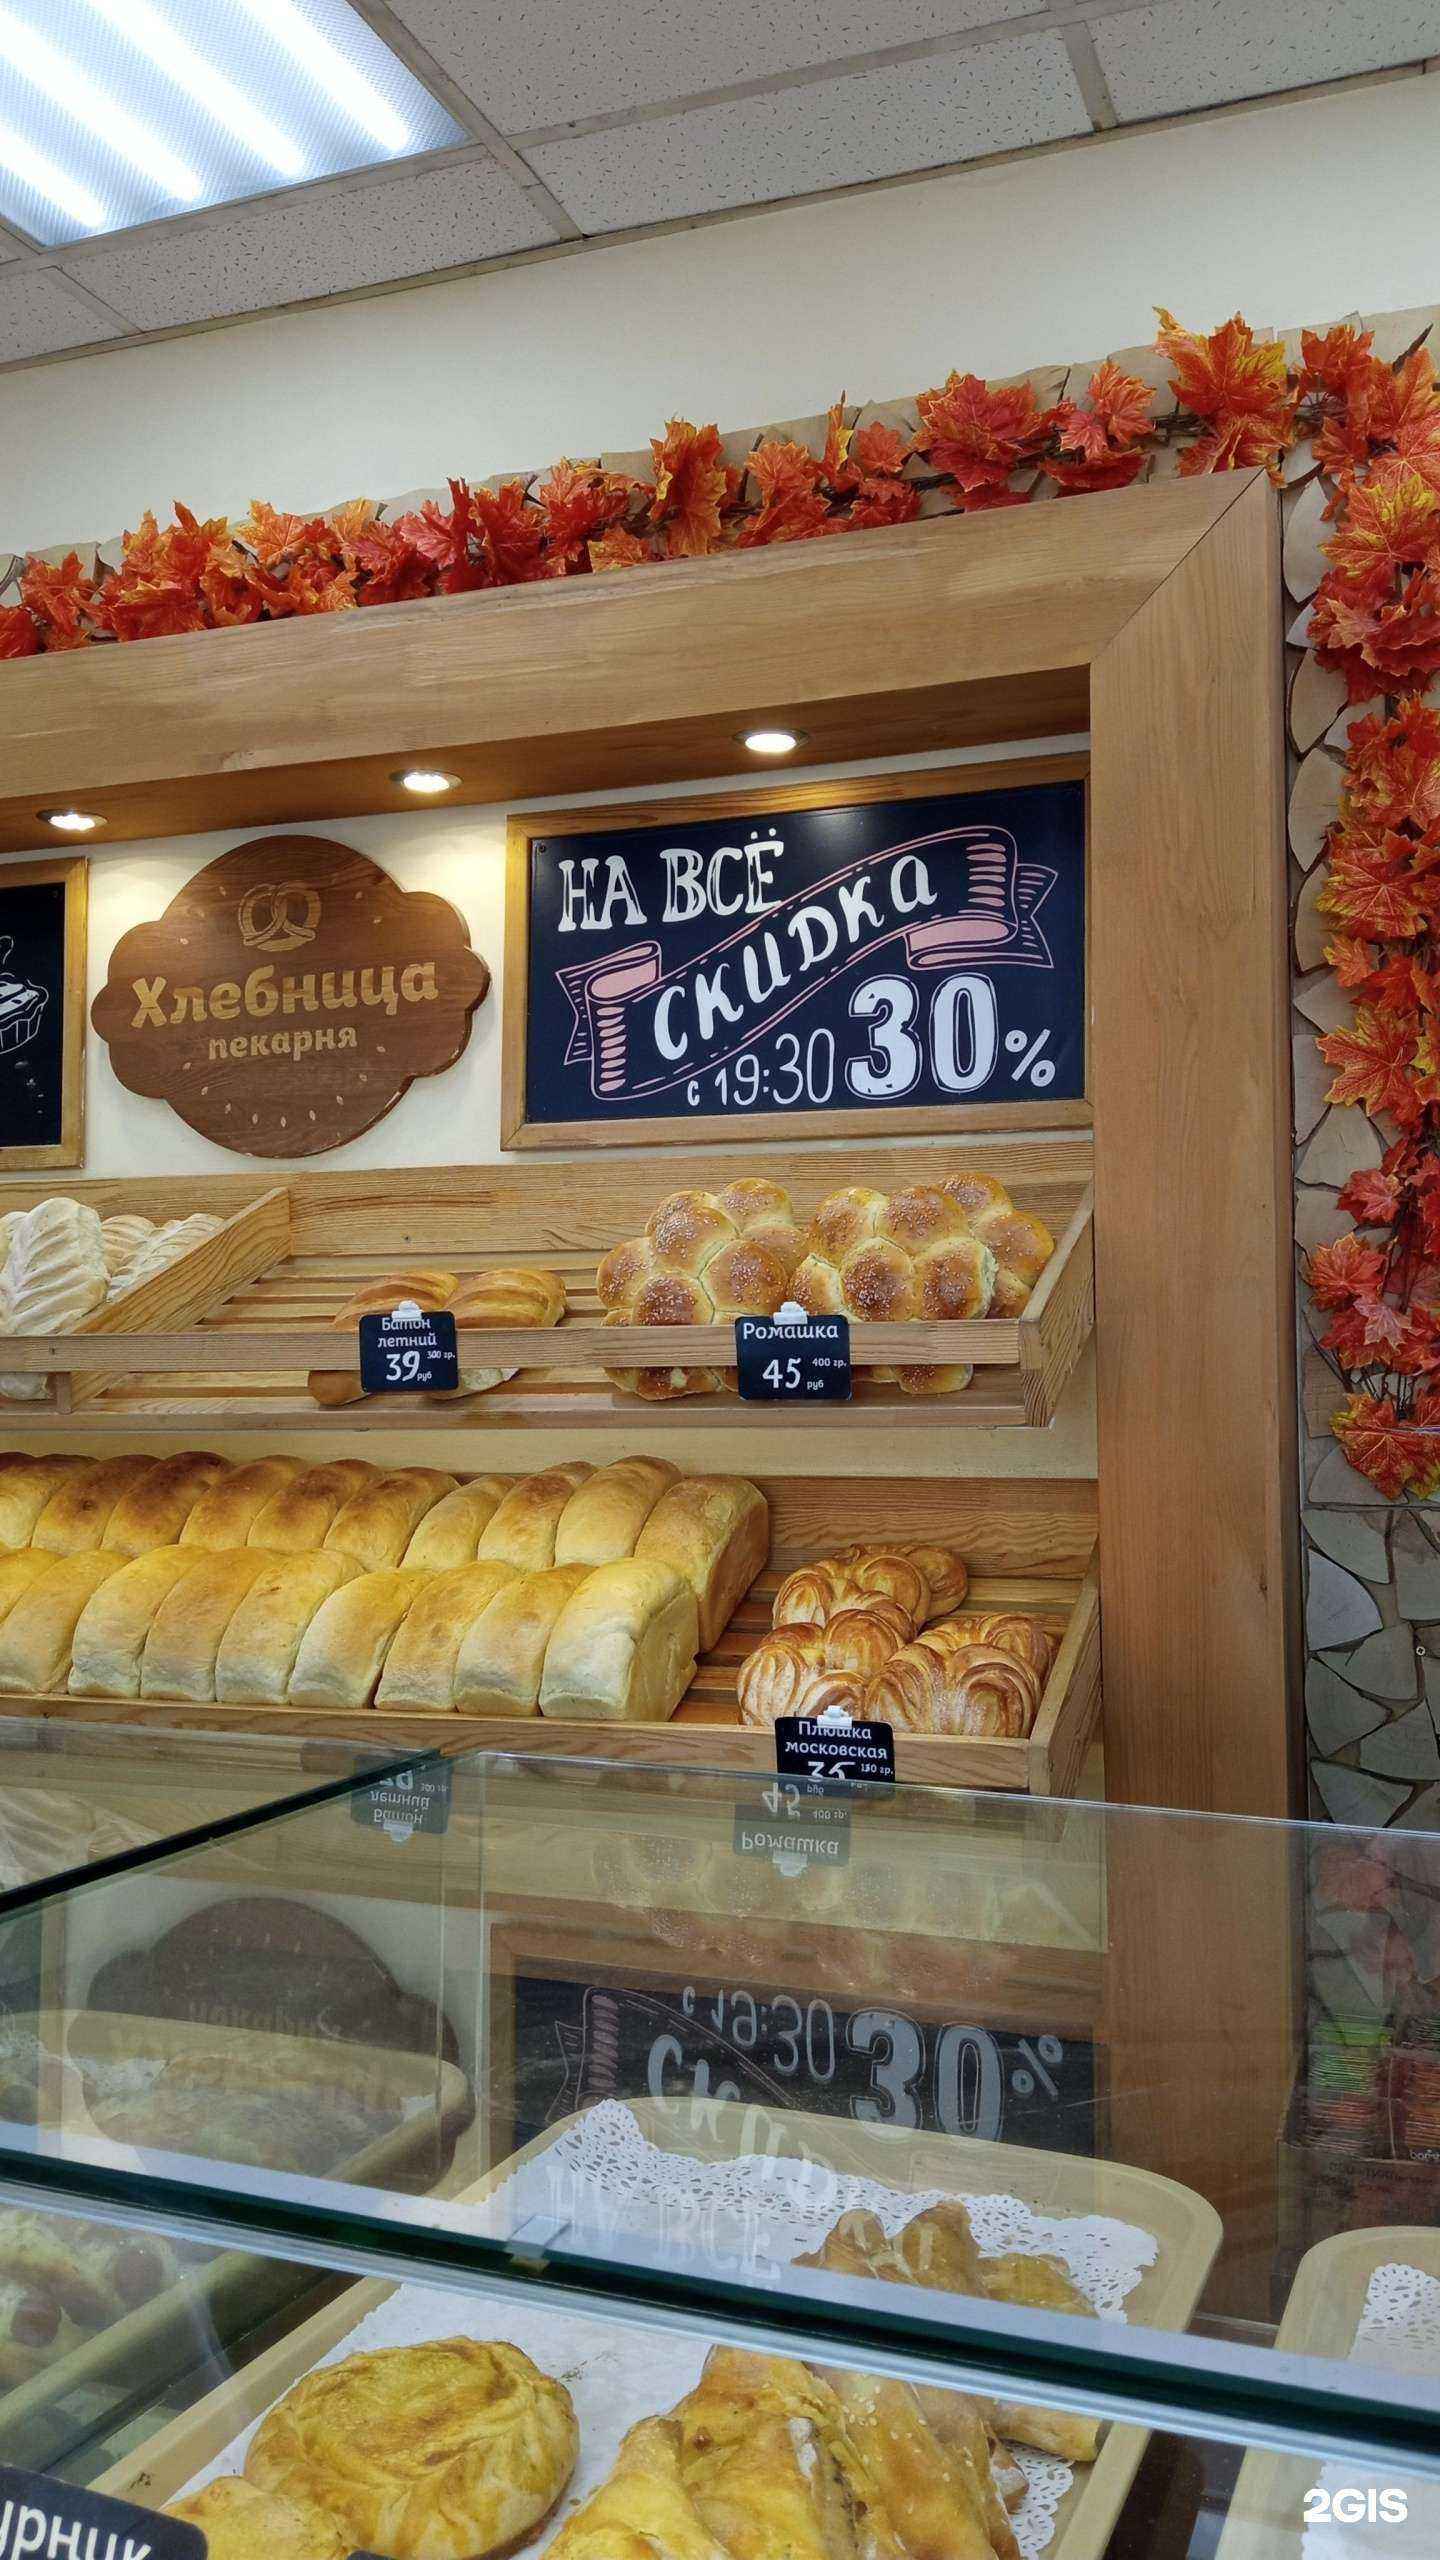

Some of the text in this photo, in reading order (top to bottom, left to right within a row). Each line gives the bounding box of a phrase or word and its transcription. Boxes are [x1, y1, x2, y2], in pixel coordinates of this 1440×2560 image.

[557, 827, 785, 932] НА ВСЁ
[131, 961, 440, 1029] Хлебница
[208, 1026, 358, 1061] пекарня
[686, 1028, 836, 1106] с 19:30
[381, 1317, 432, 1331] Батон
[743, 1322, 839, 1340] Ромашка
[377, 1332, 438, 1348] летний
[386, 1350, 433, 1382] 39 руб
[762, 1357, 824, 1391] 45 руб
[812, 1357, 832, 1367] 400
[798, 1721, 873, 1739] Плюшка
[785, 1741, 888, 1759] московская
